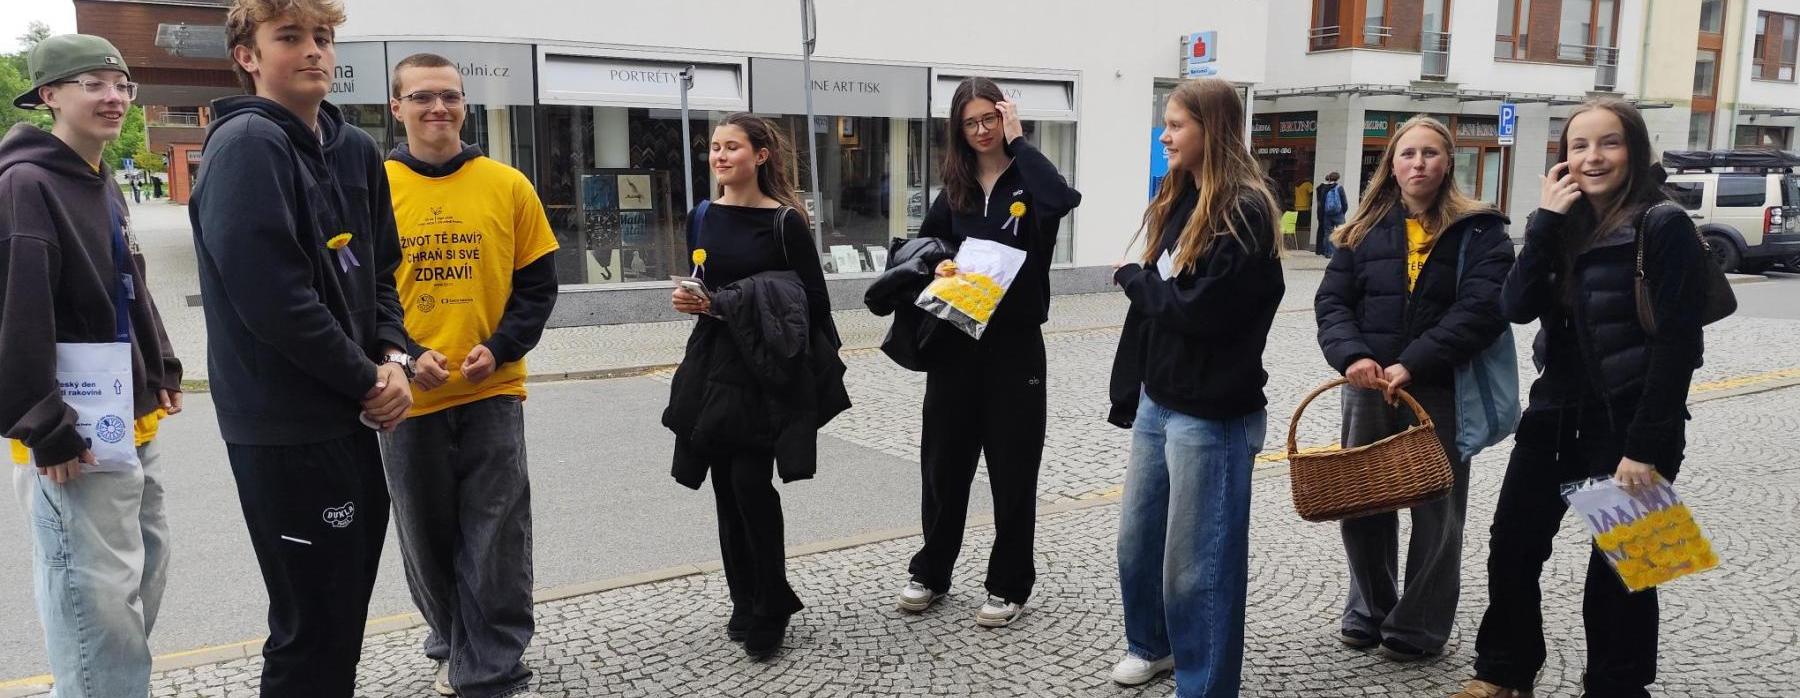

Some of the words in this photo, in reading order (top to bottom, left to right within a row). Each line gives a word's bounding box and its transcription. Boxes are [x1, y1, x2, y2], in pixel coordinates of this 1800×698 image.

[334, 65, 354, 79] na
[609, 69, 678, 83] PORTRÉTY
[810, 80, 830, 92] INE
[833, 81, 854, 93] ART
[857, 82, 881, 94] TISK
[1503, 107, 1512, 127] P
[401, 234, 431, 249] ŽIVOT
[434, 231, 448, 244] TĚ
[452, 231, 482, 244] BAVÍ?
[446, 249, 455, 260] SI
[459, 247, 480, 260] SVÉ
[415, 262, 472, 281] ZDRAVÍ!
[59, 381, 79, 389] eský
